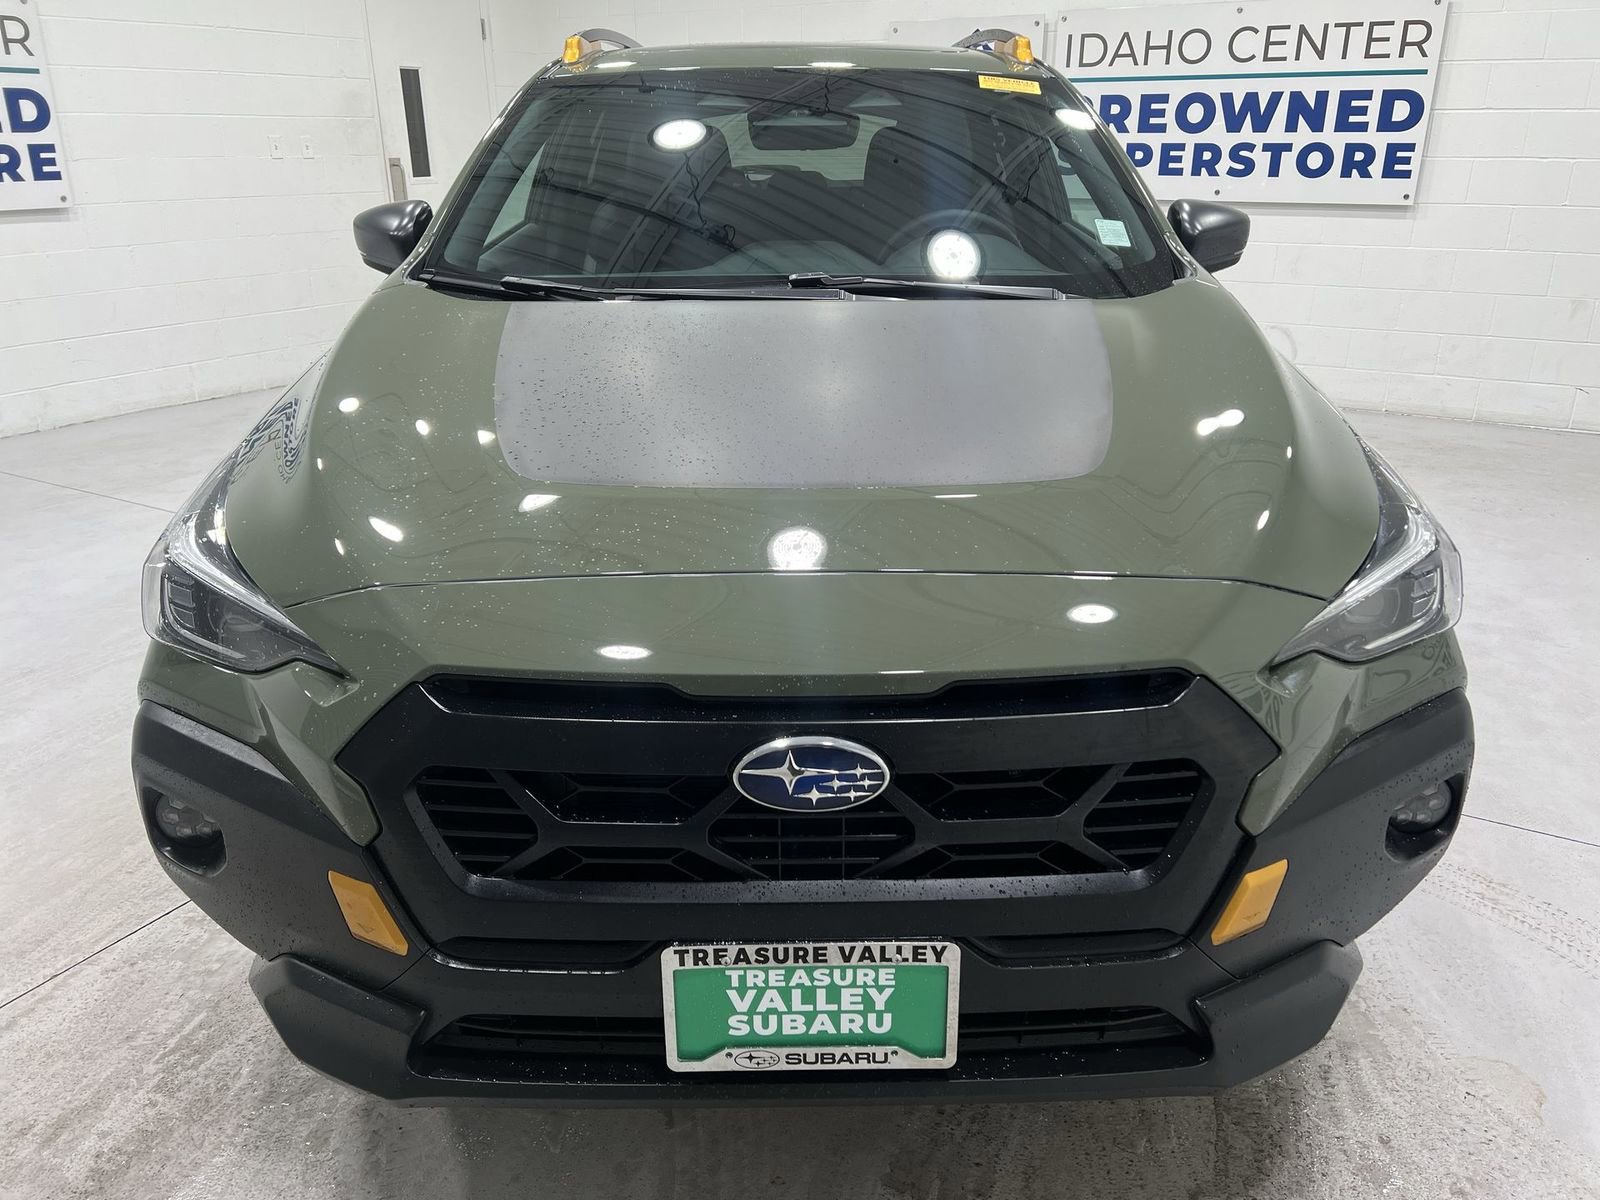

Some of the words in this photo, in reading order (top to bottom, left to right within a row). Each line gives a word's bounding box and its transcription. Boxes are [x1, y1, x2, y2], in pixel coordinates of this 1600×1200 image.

[1065, 28, 1213, 69] IDAHO
[1227, 19, 1433, 64] CENTER
[1083, 88, 1425, 134] REOWNED
[1125, 142, 1416, 180] PERSTORE
[674, 946, 829, 966] TREASURE
[839, 945, 949, 963] VALLEY
[724, 968, 896, 988] TREASURE
[725, 987, 895, 1013] VALLEY
[727, 1013, 893, 1036] SUBARU
[785, 1052, 889, 1065] SUBARU
